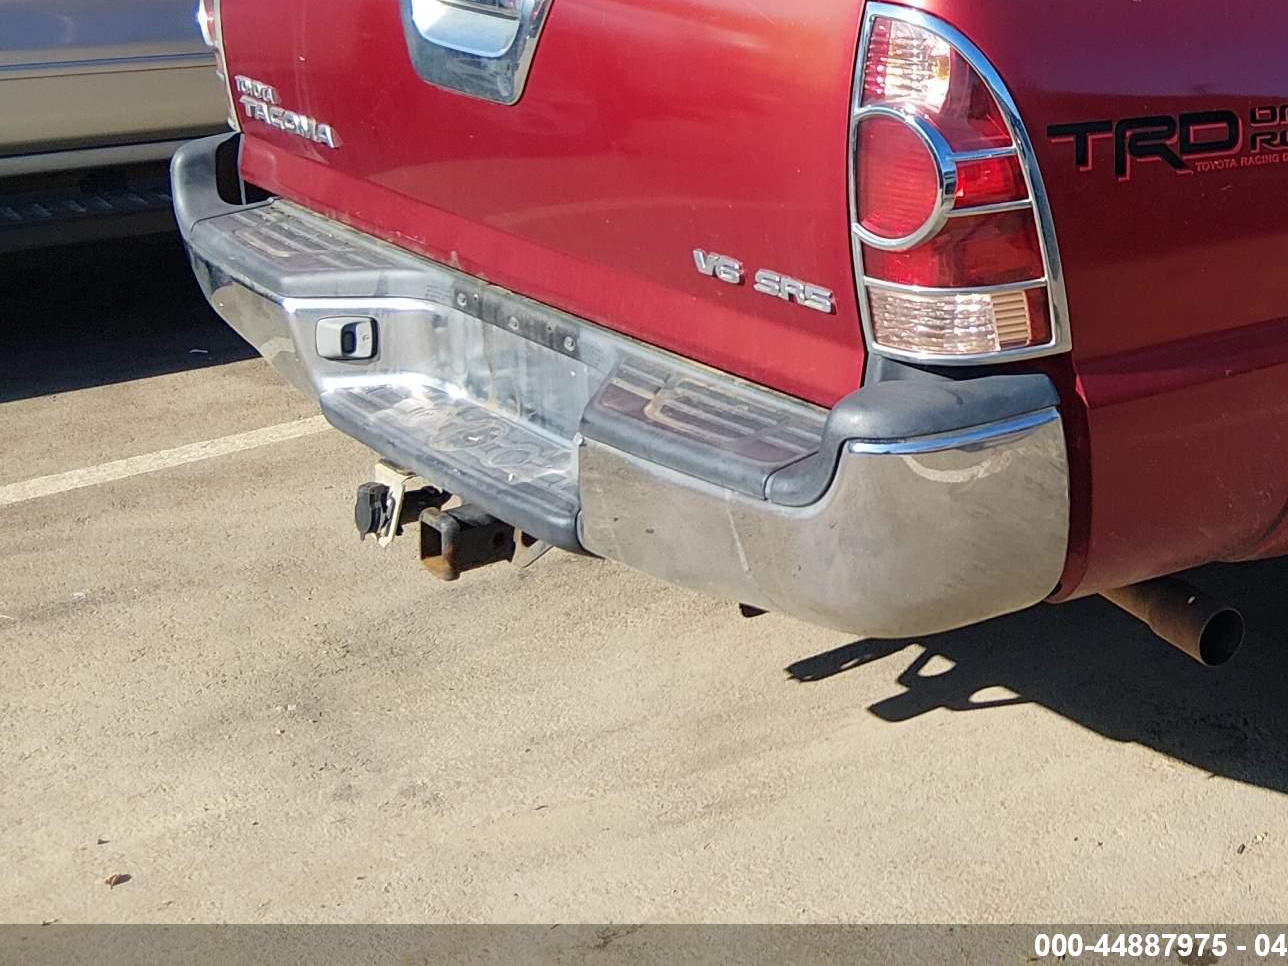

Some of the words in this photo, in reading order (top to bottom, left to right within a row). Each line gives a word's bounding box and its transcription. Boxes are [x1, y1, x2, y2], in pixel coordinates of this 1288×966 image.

[234, 75, 277, 103] TOYOTA
[240, 96, 337, 148] TACOMA
[1046, 109, 1244, 181] TRD
[1194, 158, 1238, 173] TOYOTA
[1240, 153, 1280, 168] RACING
[693, 249, 743, 284] V6
[753, 268, 834, 313] SR5
